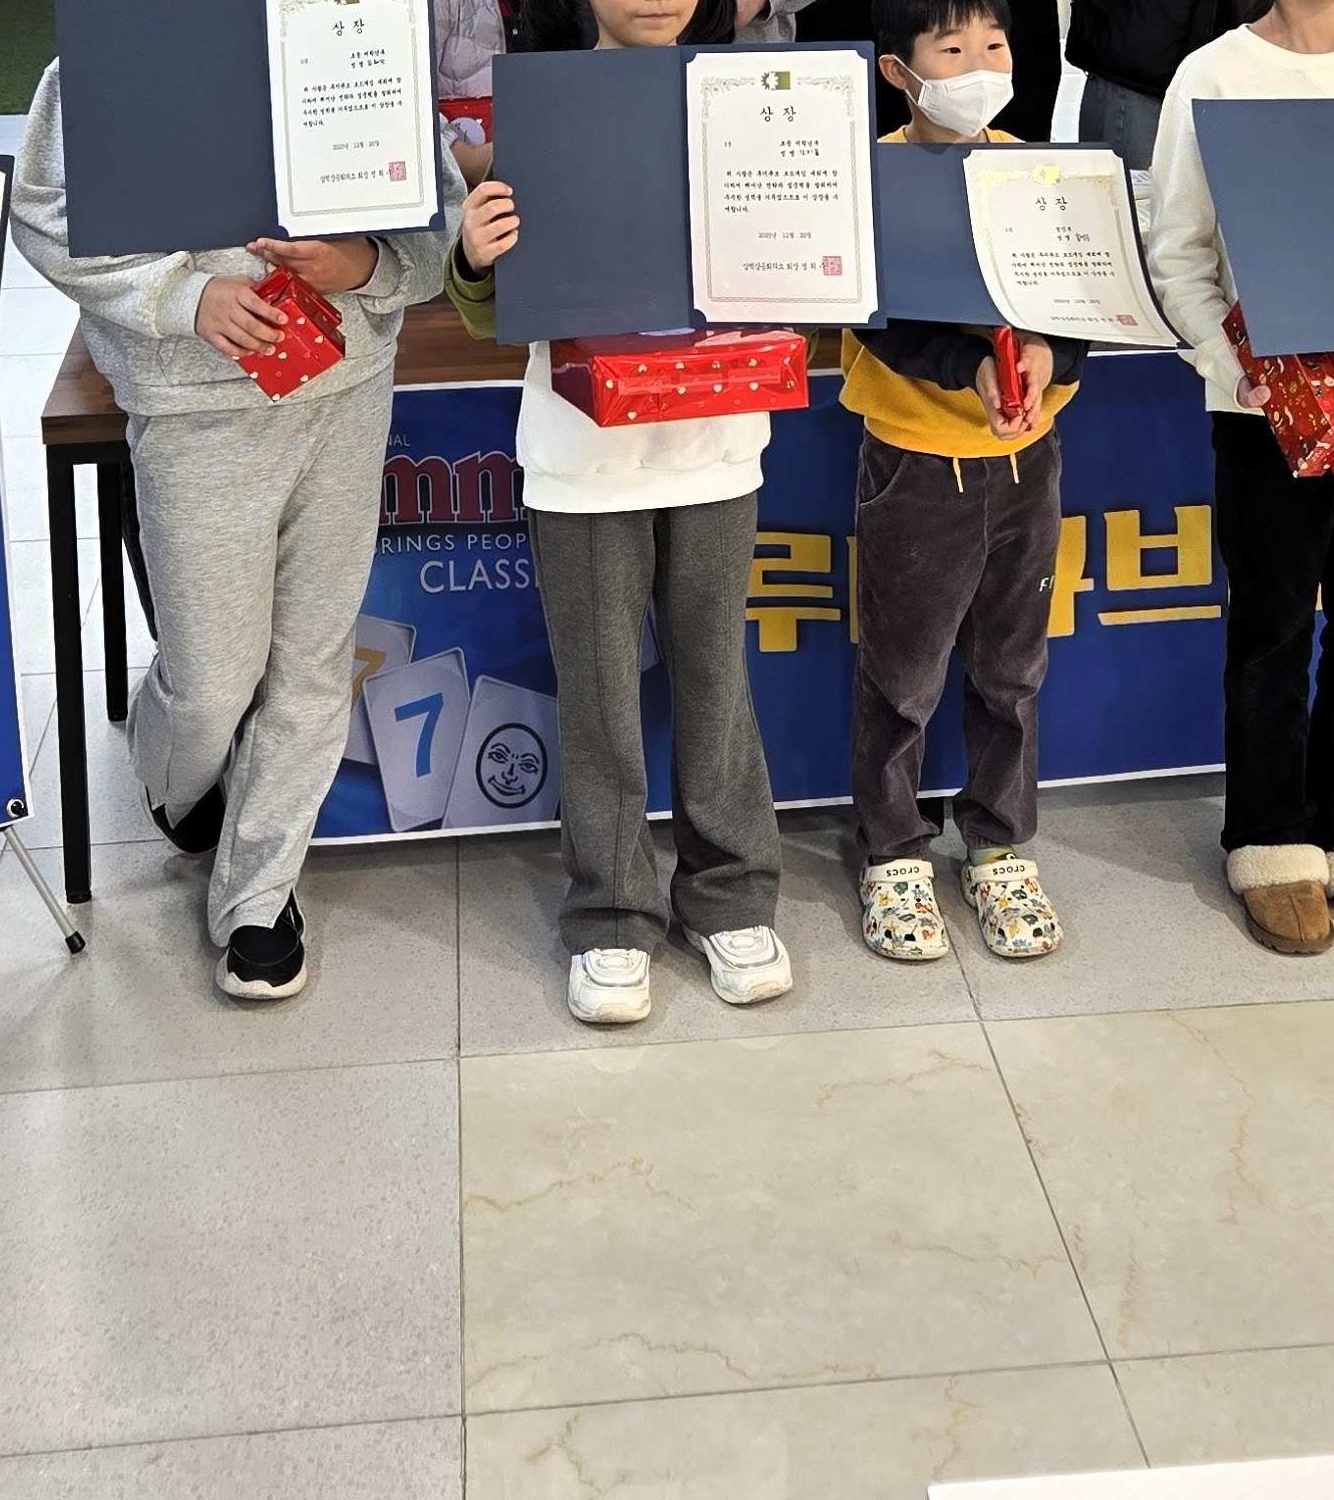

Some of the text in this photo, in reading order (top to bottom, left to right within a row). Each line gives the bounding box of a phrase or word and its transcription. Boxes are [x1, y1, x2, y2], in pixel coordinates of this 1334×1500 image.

[381, 533, 527, 555] RINGS PEOP
[420, 559, 531, 593] CLASS
[394, 692, 444, 779] 7
